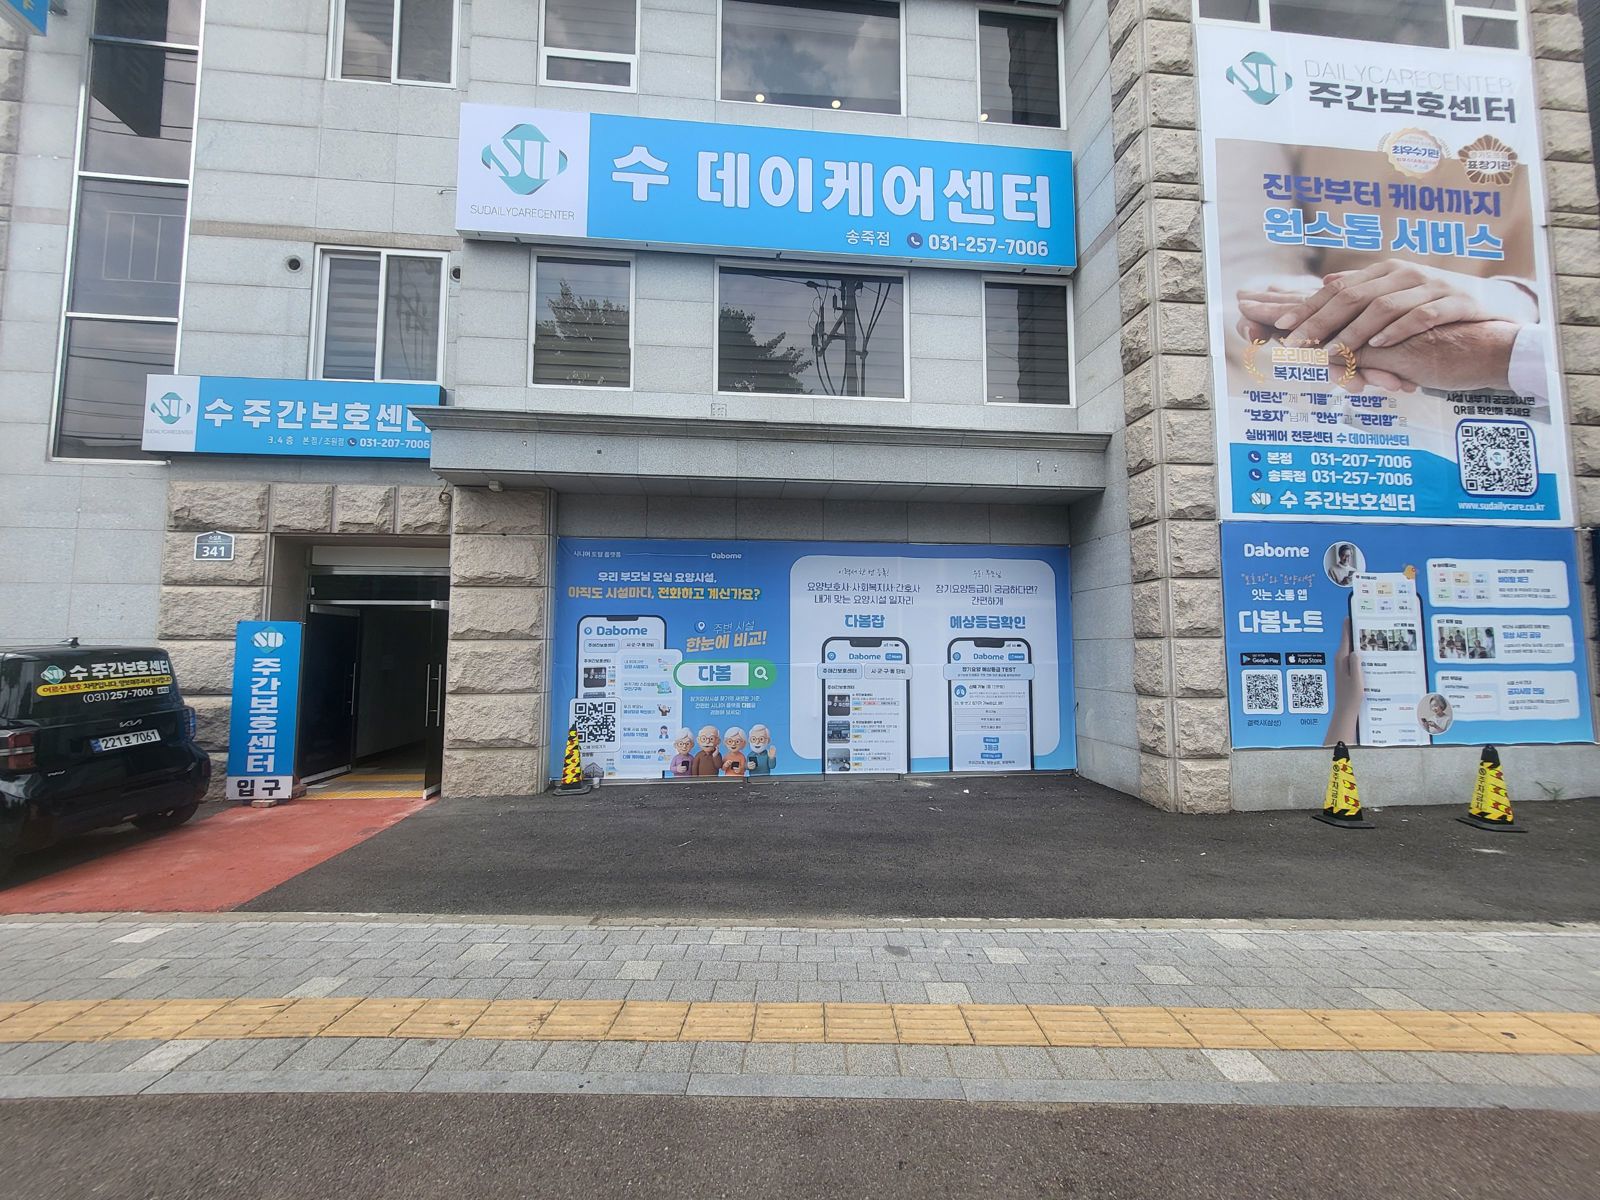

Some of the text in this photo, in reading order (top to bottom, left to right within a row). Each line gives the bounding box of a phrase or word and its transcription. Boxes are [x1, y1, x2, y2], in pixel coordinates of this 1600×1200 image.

[1304, 59, 1514, 95] DAILYCARECENTER
[1308, 81, 1517, 124] 주간보호센터
[1392, 145, 1440, 158] 최우수기관
[611, 145, 1052, 229] 수 데이케어센터
[1263, 173, 1501, 217] 진단부터 케어까지
[470, 204, 575, 221] SUDAILYCARECENTER
[845, 229, 891, 247] 송죽점
[1263, 207, 1505, 260] 원스톱 서비스
[928, 233, 1049, 257] 031-257-7006
[1271, 347, 1329, 366] 프리미엄
[1274, 366, 1329, 382] 복지센터
[204, 398, 234, 427] 수
[1454, 405, 1531, 417] QR을 확인해 주세요
[359, 438, 430, 449] 031-207-7006
[1246, 428, 1410, 446] 실버케어 전문센터 수 데이케어센터
[1267, 451, 1412, 468] 본점 031-207-7006
[1268, 470, 1413, 486] 송죽점 031-257-7006
[1279, 491, 1298, 509] 수
[1304, 491, 1416, 512] 주간보호센터
[1458, 502, 1546, 511] www.sudailycare.co.kr
[202, 546, 225, 557] 341
[1244, 542, 1309, 557] Dabome
[598, 572, 718, 584] 우리 부모님 모실 요양시설,
[568, 586, 761, 601] 아직도 시설마다, 전화하고 계신가요?
[936, 584, 1039, 595] 장기요양등급이 궁금하다면?
[1252, 589, 1308, 600] 잇는 소통 앱
[814, 594, 914, 605] 내게 맞는 요양시설 일자리
[972, 596, 1004, 606] 간편하게
[714, 620, 755, 634] 주변 시설
[844, 614, 885, 628] 다봄잡
[950, 615, 1026, 629] 예상등급확인
[1239, 610, 1323, 633] 다봄노트
[596, 626, 648, 636] Dabome
[686, 631, 767, 653] 한눈에 비교!
[70, 660, 170, 681] 수 주간보호센터
[698, 665, 732, 682] 다봄
[247, 657, 281, 774] 주간보호센터
